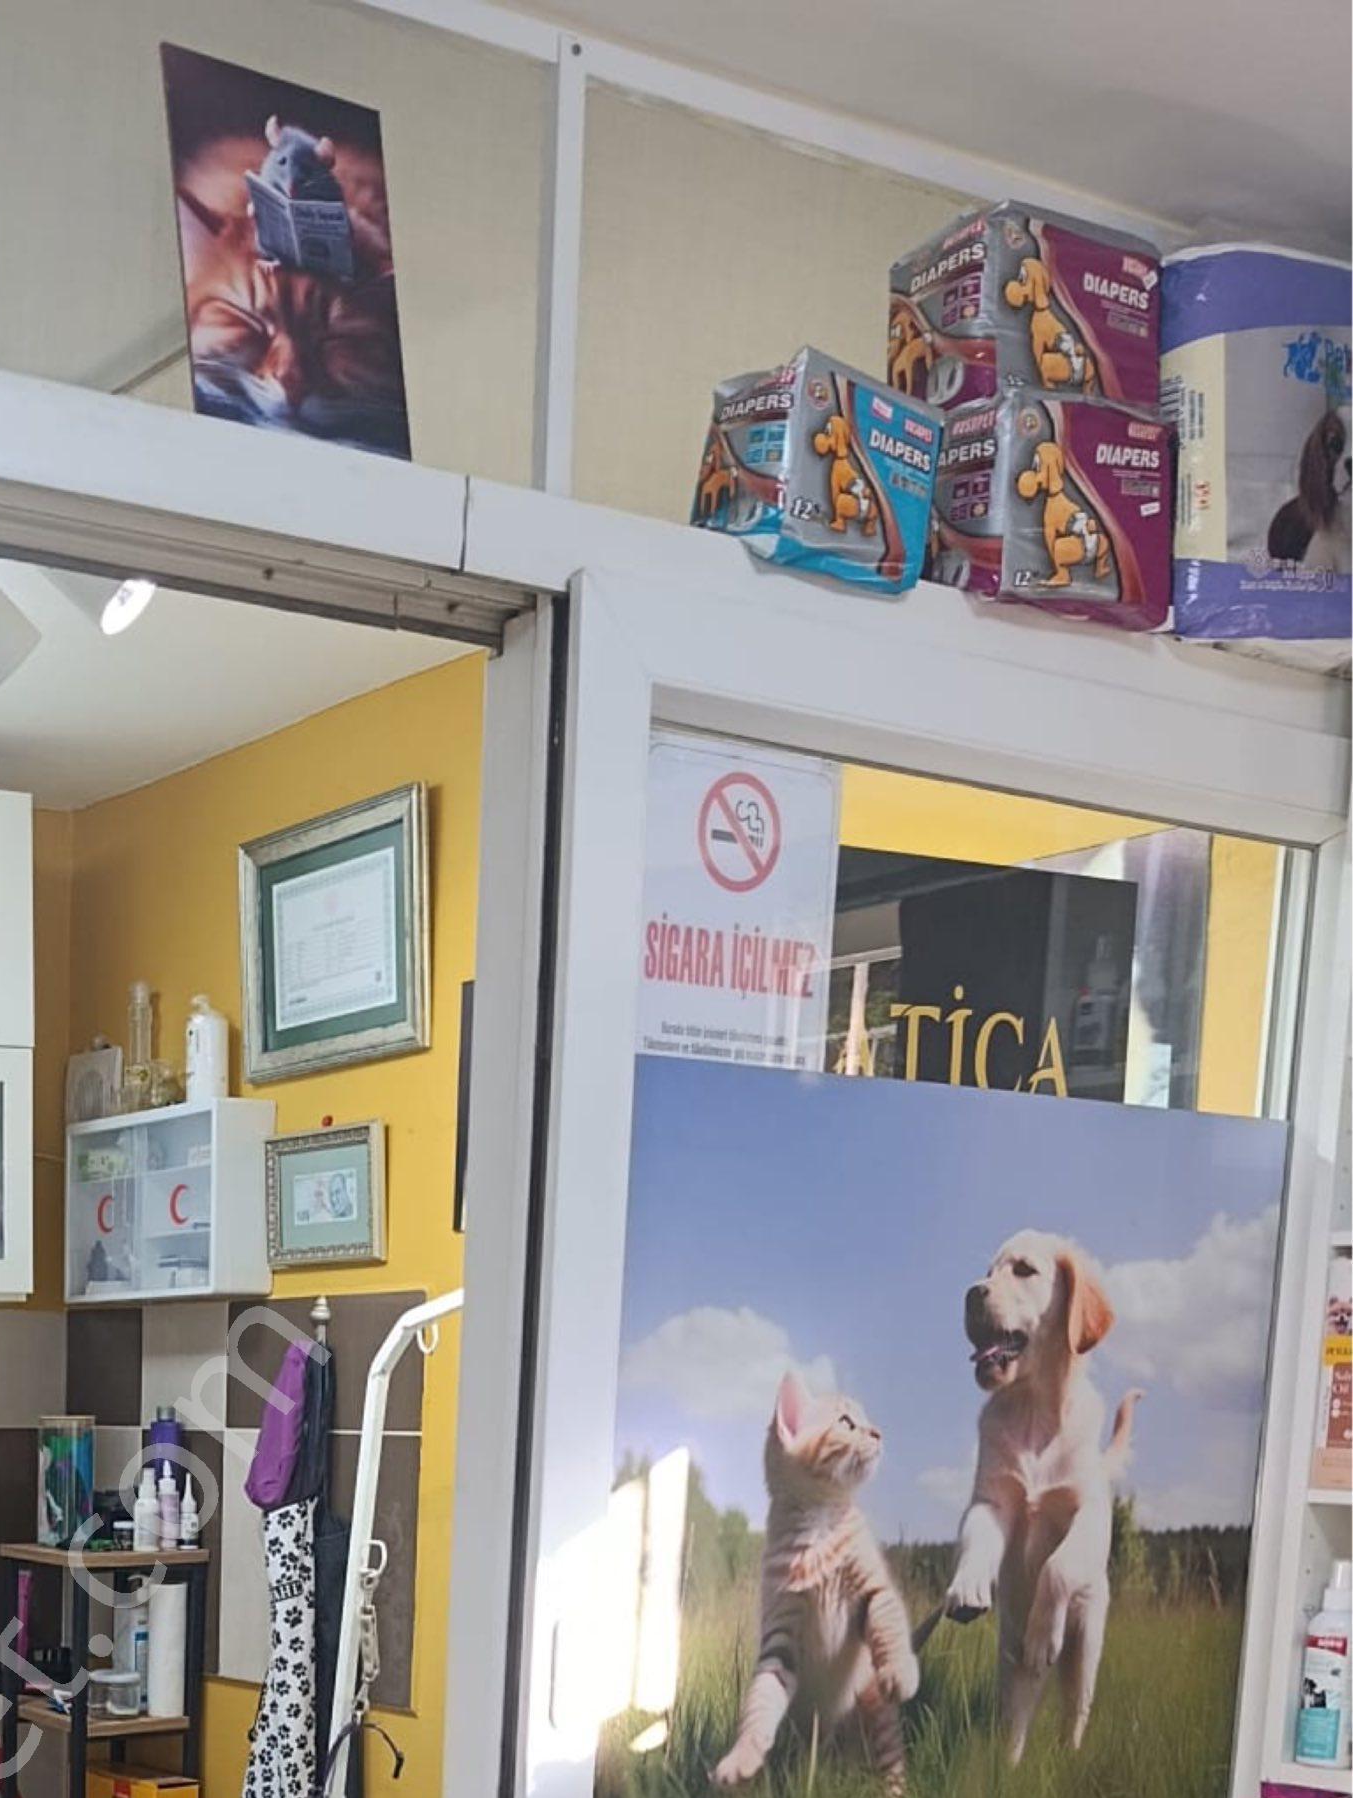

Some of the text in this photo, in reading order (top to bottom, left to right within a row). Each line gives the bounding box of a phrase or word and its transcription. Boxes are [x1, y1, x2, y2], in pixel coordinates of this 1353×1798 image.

[909, 241, 985, 292] DIAPERS
[1083, 272, 1149, 309] DIAPERS
[720, 391, 795, 421] DIAPERS
[869, 427, 932, 472] DIAPERS
[1096, 443, 1159, 469] DIAPERS
[645, 912, 724, 988] SİGARA
